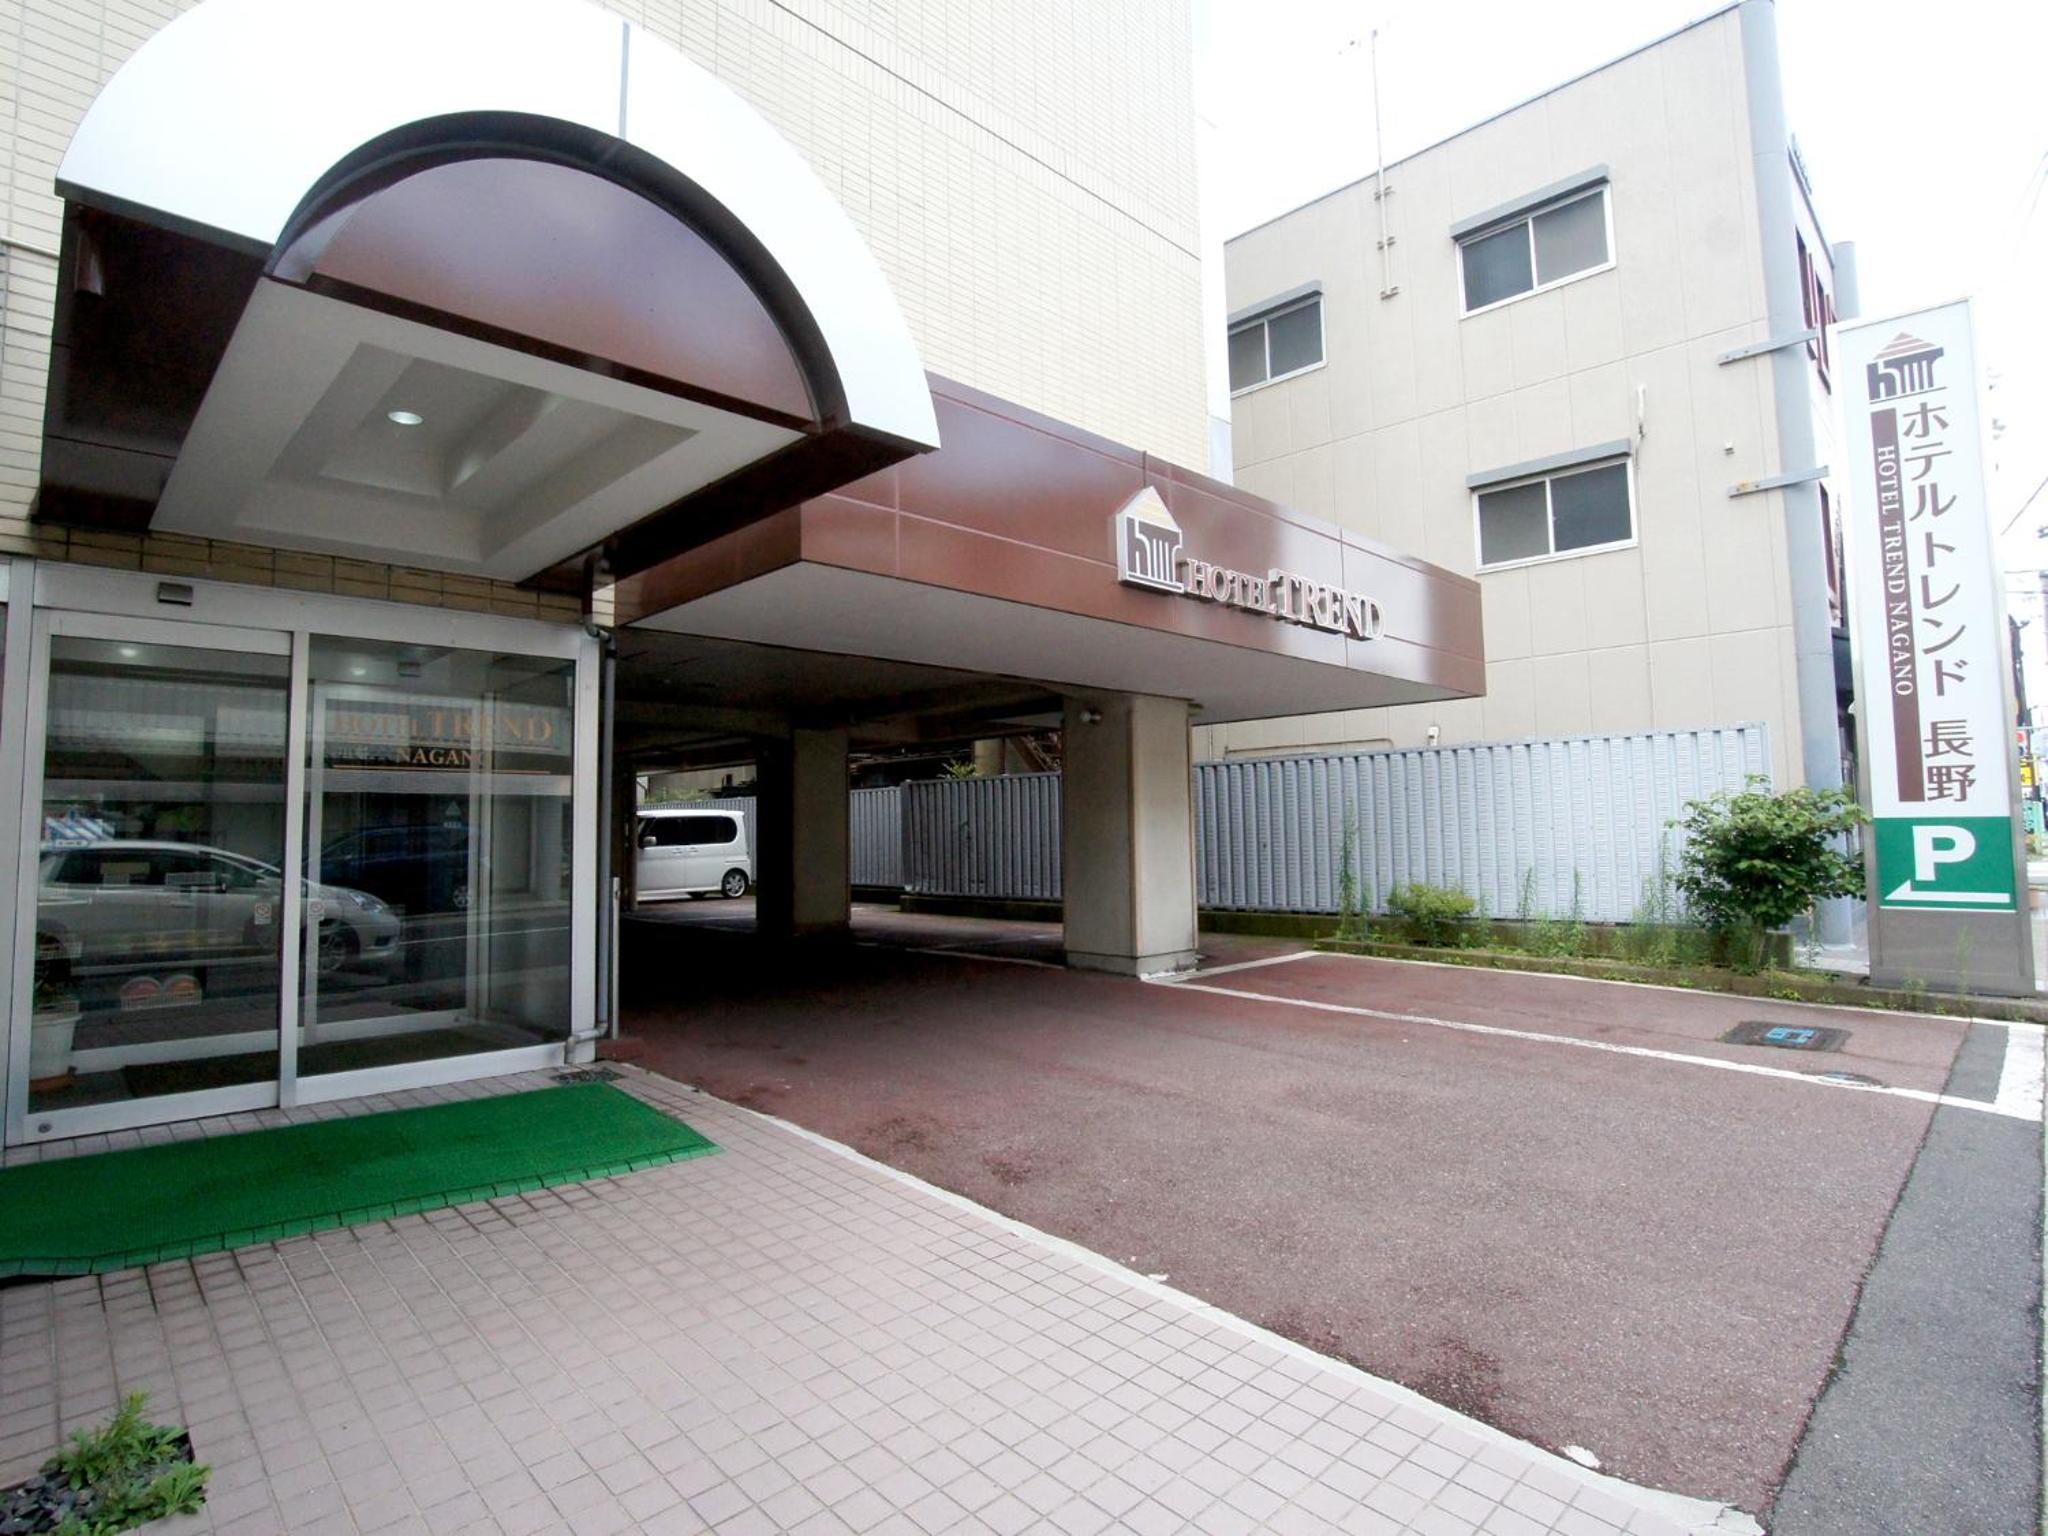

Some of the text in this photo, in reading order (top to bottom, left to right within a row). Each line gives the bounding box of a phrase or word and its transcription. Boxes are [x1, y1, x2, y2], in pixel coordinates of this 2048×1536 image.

[1186, 557, 1386, 640] HOTEL TREND
[1877, 445, 1914, 696] HOTEL TREND NAGANO
[396, 747, 484, 767] NAGAN
[1912, 825, 1976, 881] P
